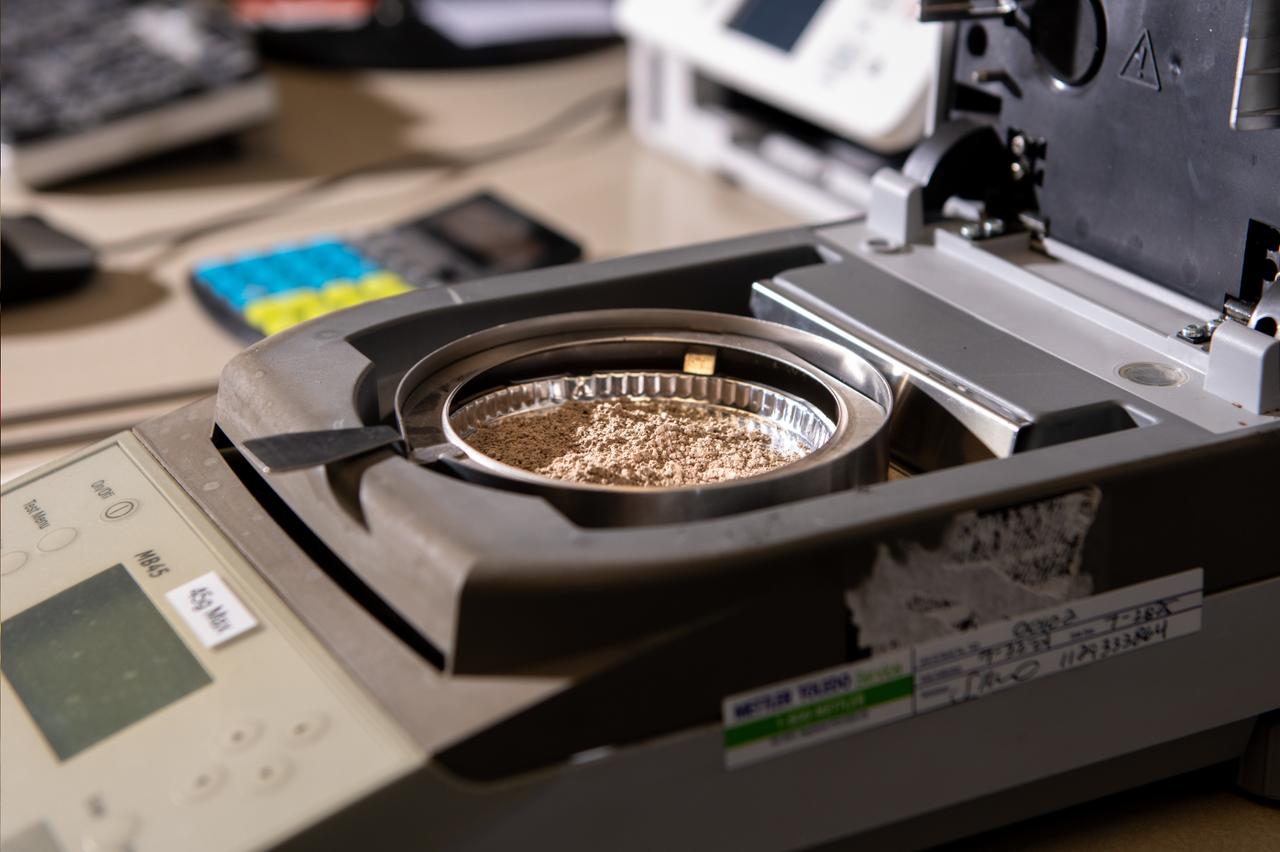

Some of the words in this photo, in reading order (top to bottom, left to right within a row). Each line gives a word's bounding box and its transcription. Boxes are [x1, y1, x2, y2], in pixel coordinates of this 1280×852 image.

[23, 499, 41, 516] Test
[31, 510, 51, 530] Menu
[133, 549, 170, 578] MB45
[189, 587, 213, 611] 45g
[204, 604, 231, 633] Max
